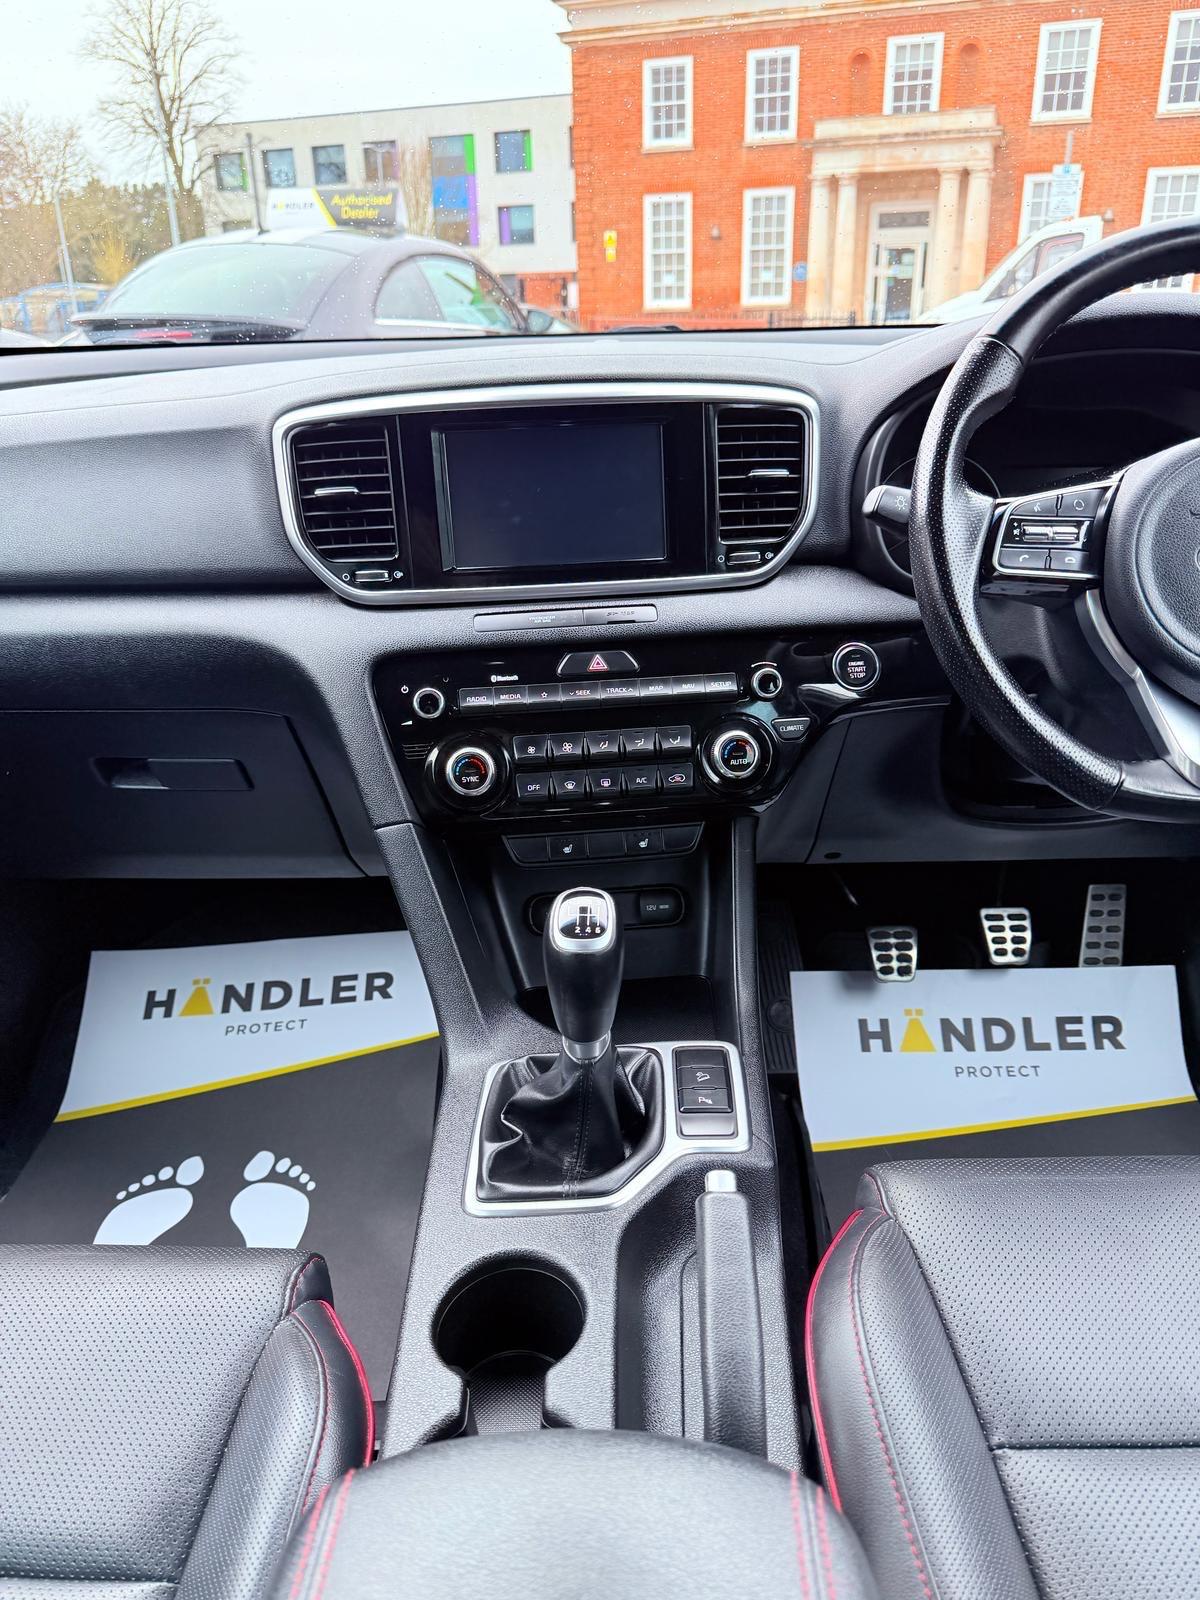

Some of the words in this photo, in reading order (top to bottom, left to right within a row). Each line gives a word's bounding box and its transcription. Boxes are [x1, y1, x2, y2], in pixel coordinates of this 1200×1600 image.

[779, 724, 804, 732] CLIMATE
[143, 971, 394, 1020] HÄNDLER
[224, 1019, 308, 1036] PROTECT
[857, 1008, 1127, 1053] HÄNDLER
[954, 1065, 1041, 1078] PROTECT
